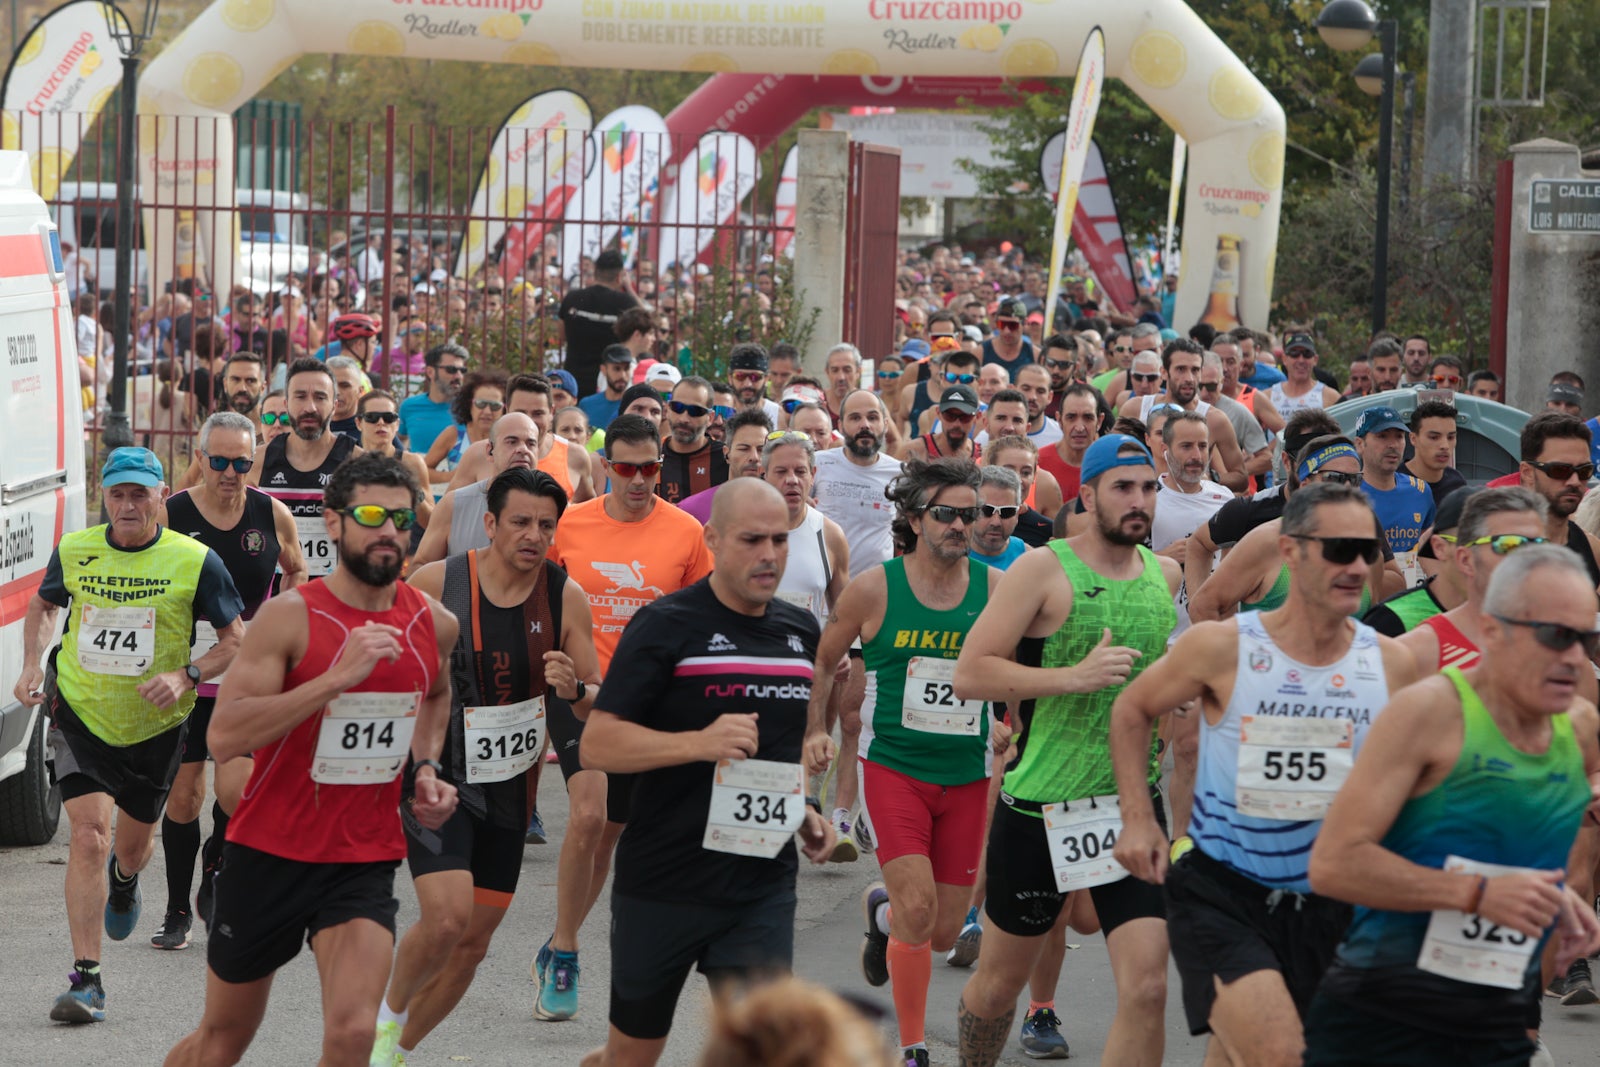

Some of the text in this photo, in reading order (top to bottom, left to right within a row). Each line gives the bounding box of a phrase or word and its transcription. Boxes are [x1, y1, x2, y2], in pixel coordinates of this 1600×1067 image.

[868, 0, 1023, 23] Cruzcampo
[404, 13, 479, 39] Radler
[582, 22, 825, 48] DOBLEMENTE REFRESCANTE
[883, 28, 957, 53] Radler
[26, 31, 94, 116] Cruzcampo
[1199, 183, 1271, 204] Cruzcampo
[1559, 184, 1600, 199] CALLE
[299, 540, 329, 558] 16
[78, 576, 172, 588] ATLETISMO
[93, 629, 138, 652] 474
[1256, 700, 1371, 725] MARACENA
[341, 721, 395, 750] 814
[477, 728, 538, 761] 3126
[1263, 751, 1327, 782] 555
[733, 792, 788, 826] 334
[1061, 828, 1118, 863] 304
